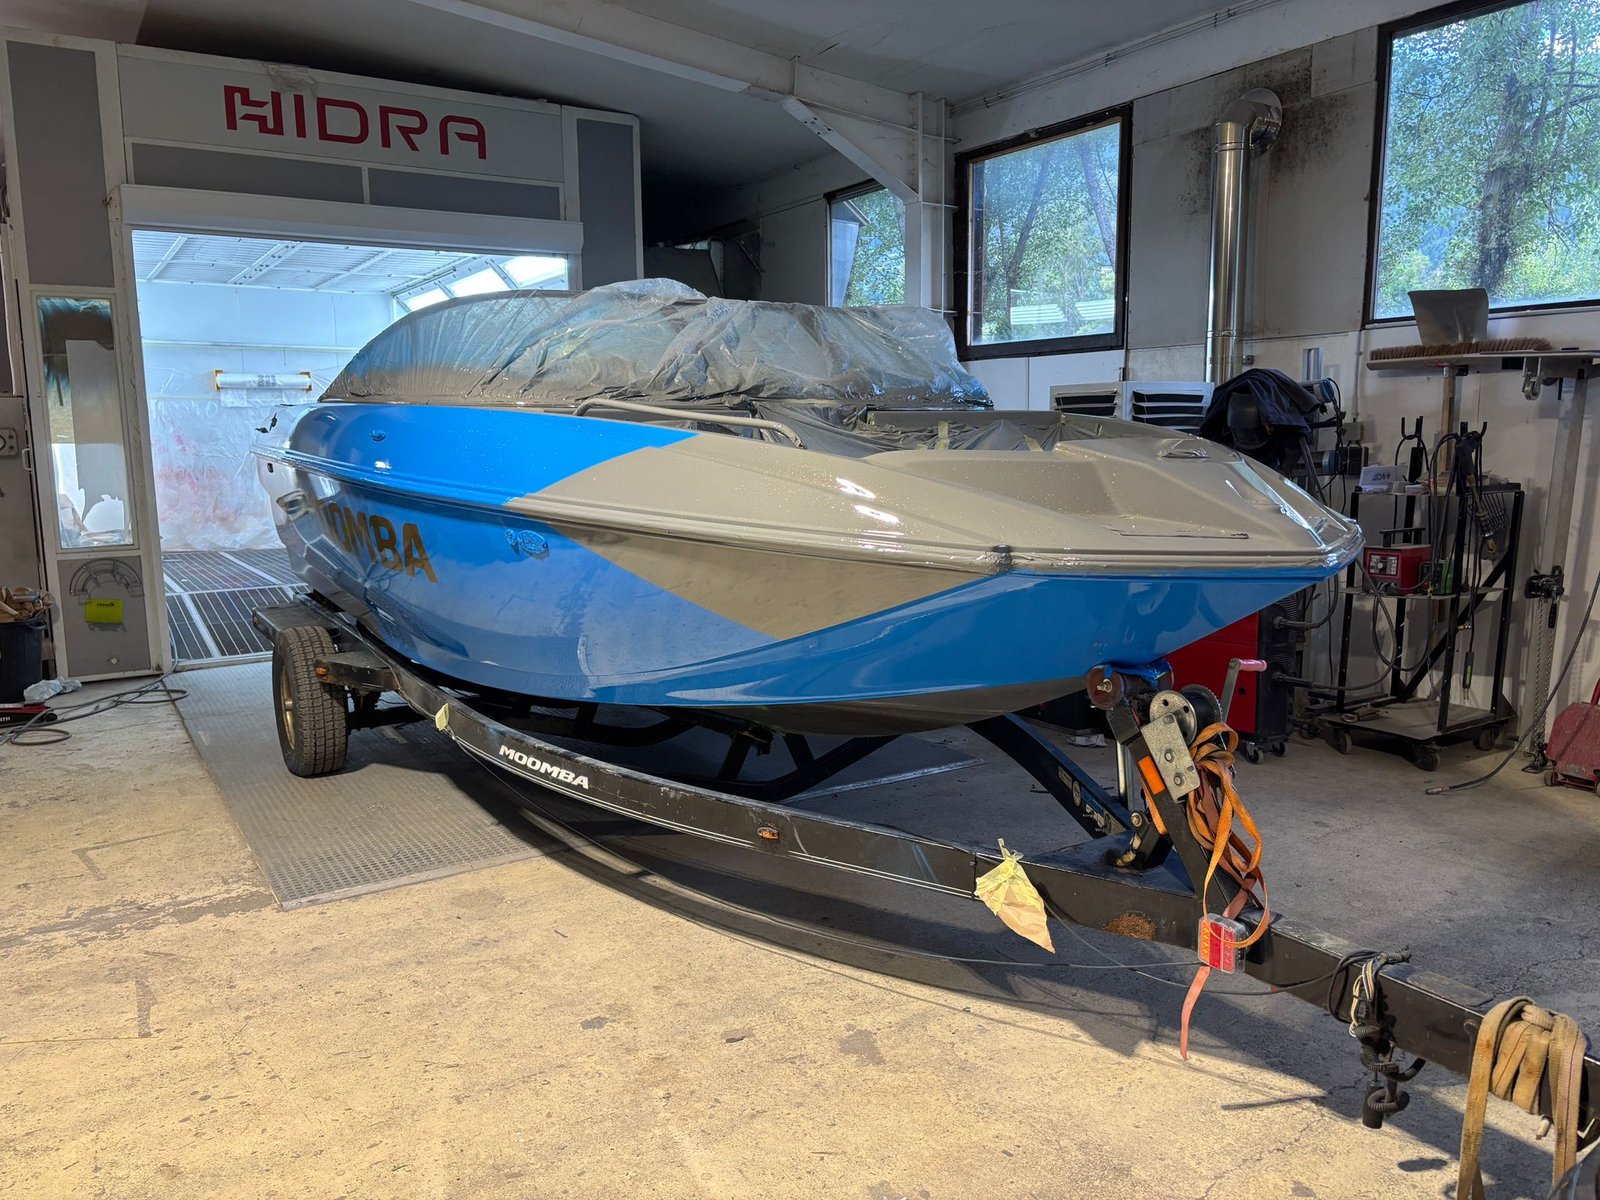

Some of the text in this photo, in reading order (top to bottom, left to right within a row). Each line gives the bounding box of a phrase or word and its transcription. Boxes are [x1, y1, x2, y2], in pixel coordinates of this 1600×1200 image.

[223, 84, 487, 160] HIDRA
[322, 500, 439, 584] OMBA
[499, 744, 589, 789] MOOMBA
